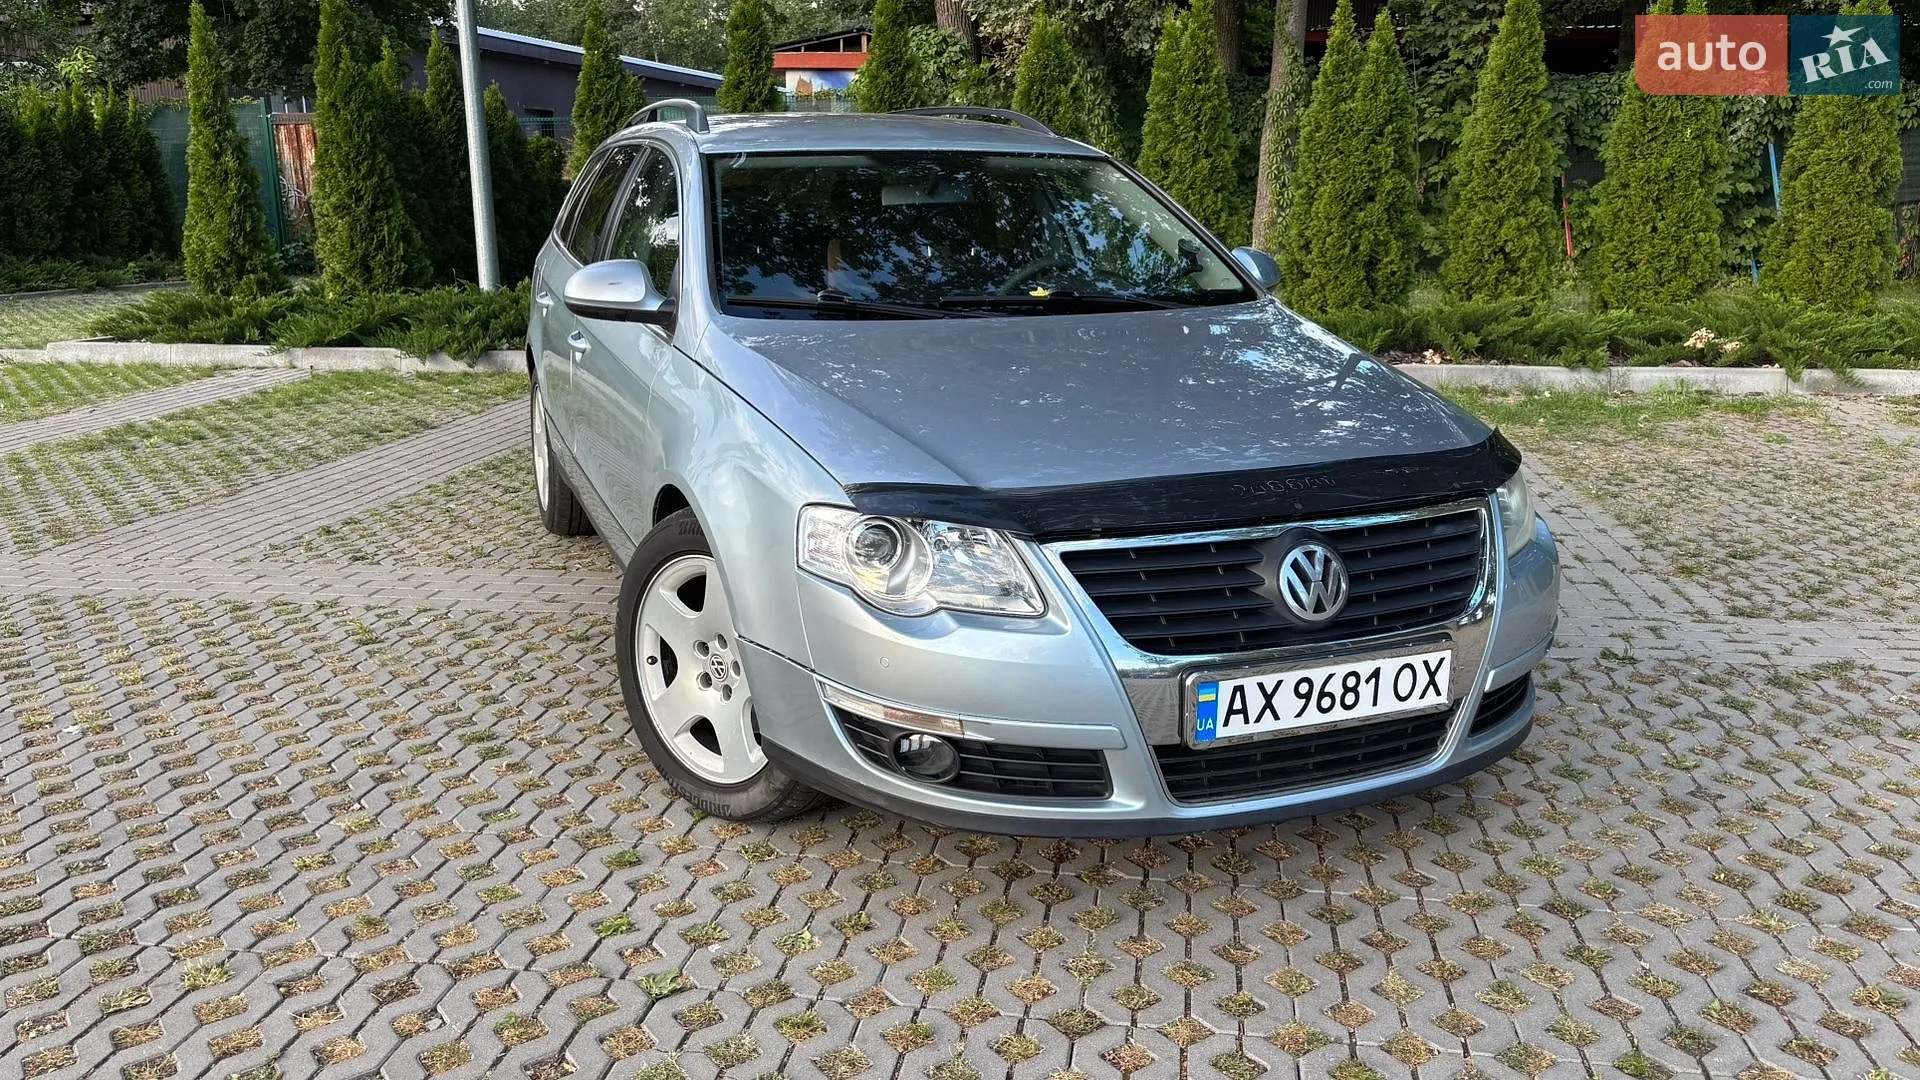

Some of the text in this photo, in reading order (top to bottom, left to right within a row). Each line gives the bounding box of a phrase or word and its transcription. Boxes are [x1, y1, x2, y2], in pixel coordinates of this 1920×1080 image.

[1222, 657, 1446, 727] AX 9681 OX
[1196, 719, 1215, 732] UA
